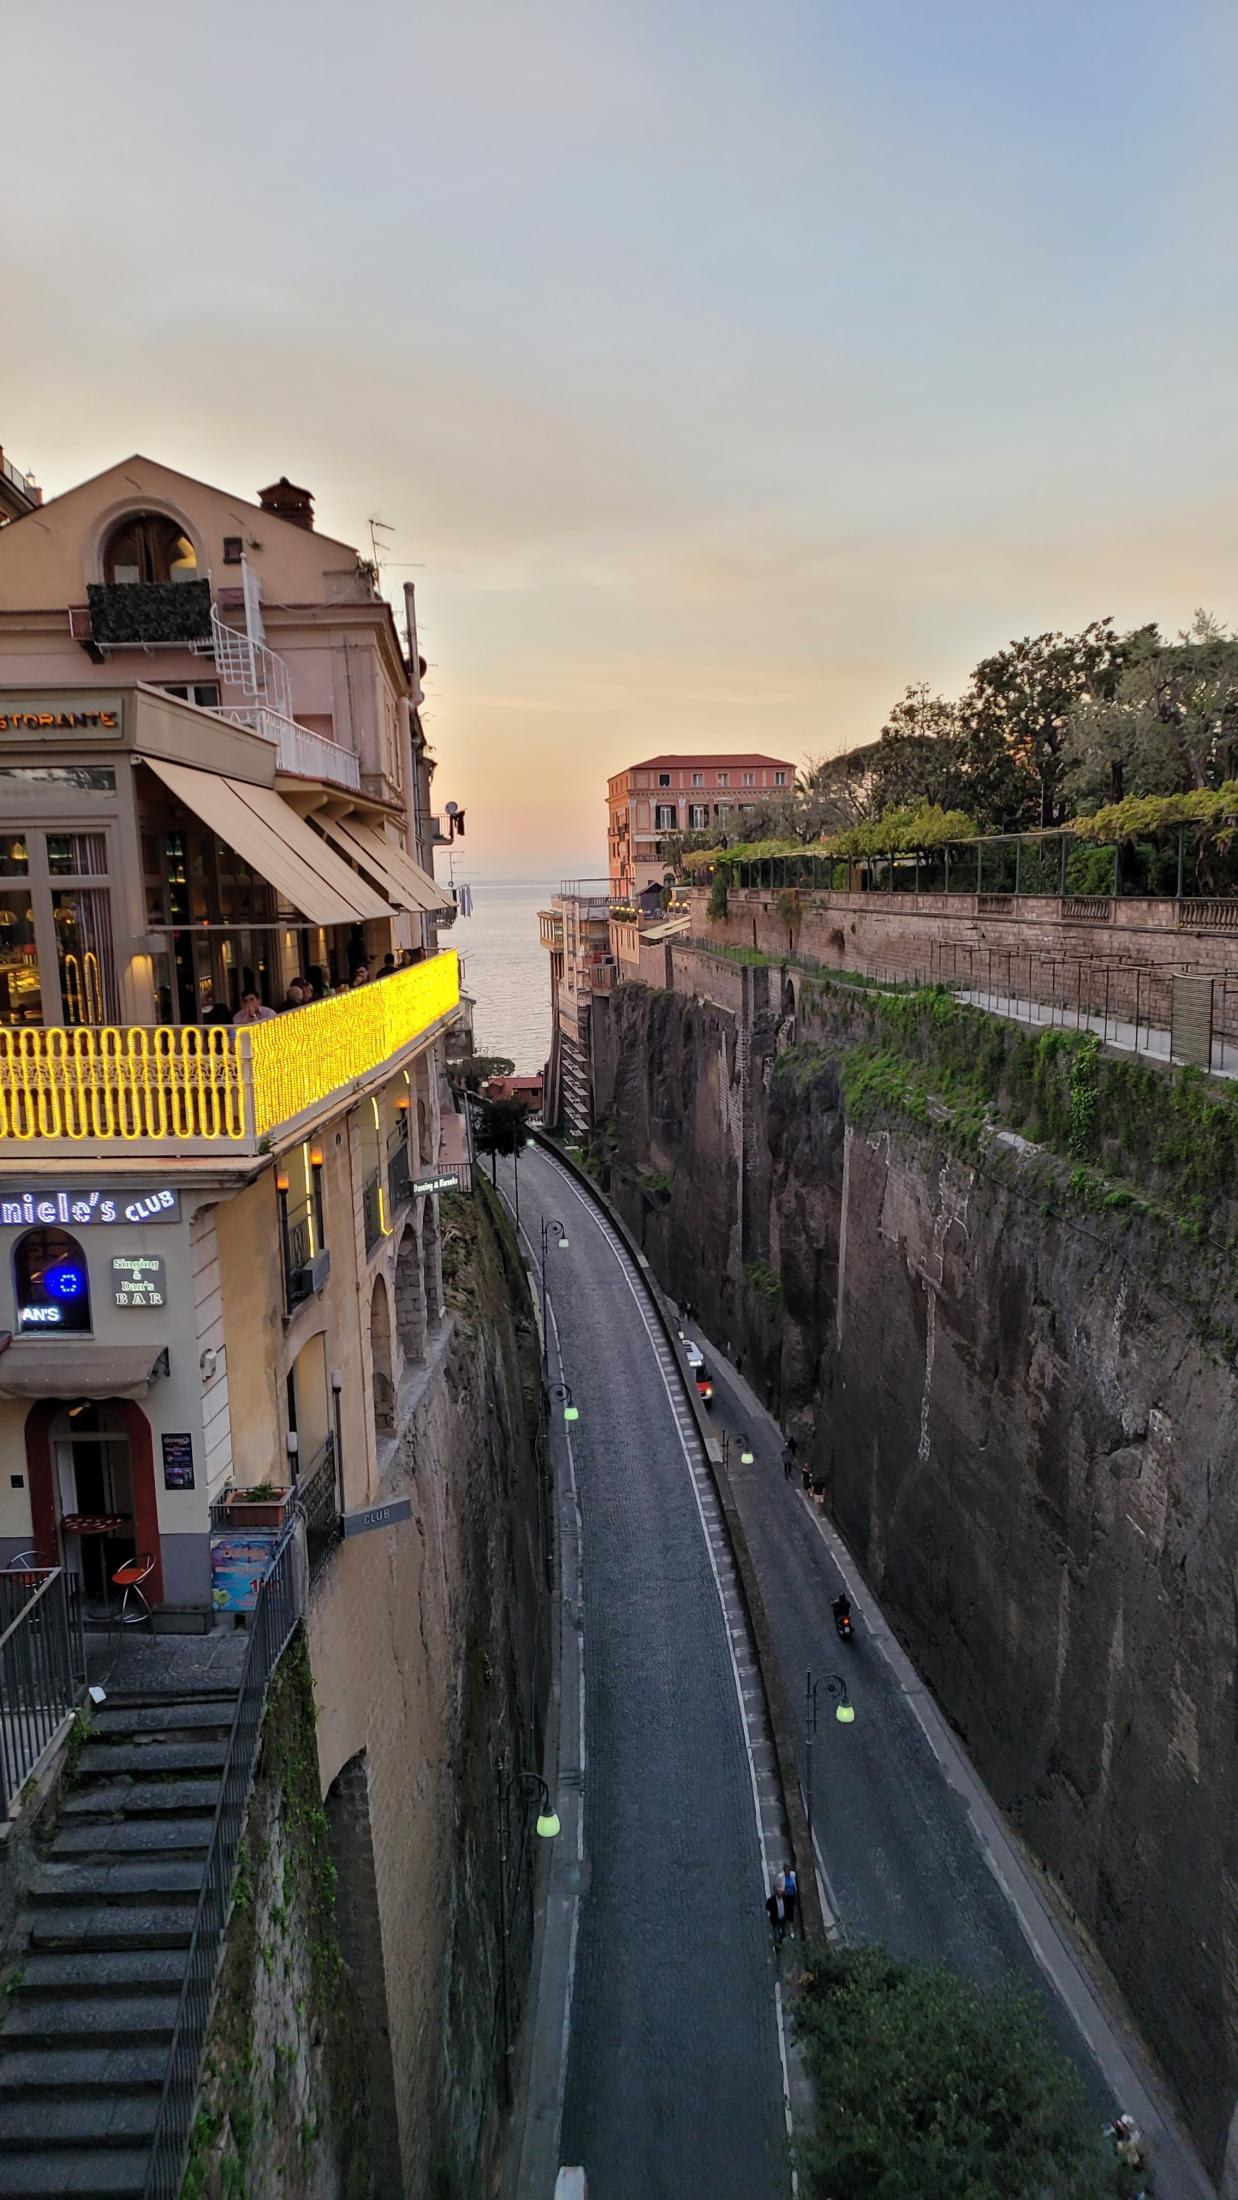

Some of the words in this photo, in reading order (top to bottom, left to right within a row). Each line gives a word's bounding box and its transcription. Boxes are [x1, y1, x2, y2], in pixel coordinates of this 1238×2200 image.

[434, 1181, 439, 1189] &
[2, 1192, 116, 1223] niele's
[124, 1190, 175, 1222] CLUB
[113, 1258, 159, 1271] Singing
[132, 1270, 142, 1280] &
[121, 1281, 154, 1292] Dan's
[115, 1292, 163, 1305] BAR
[363, 1509, 390, 1524] CLUB
